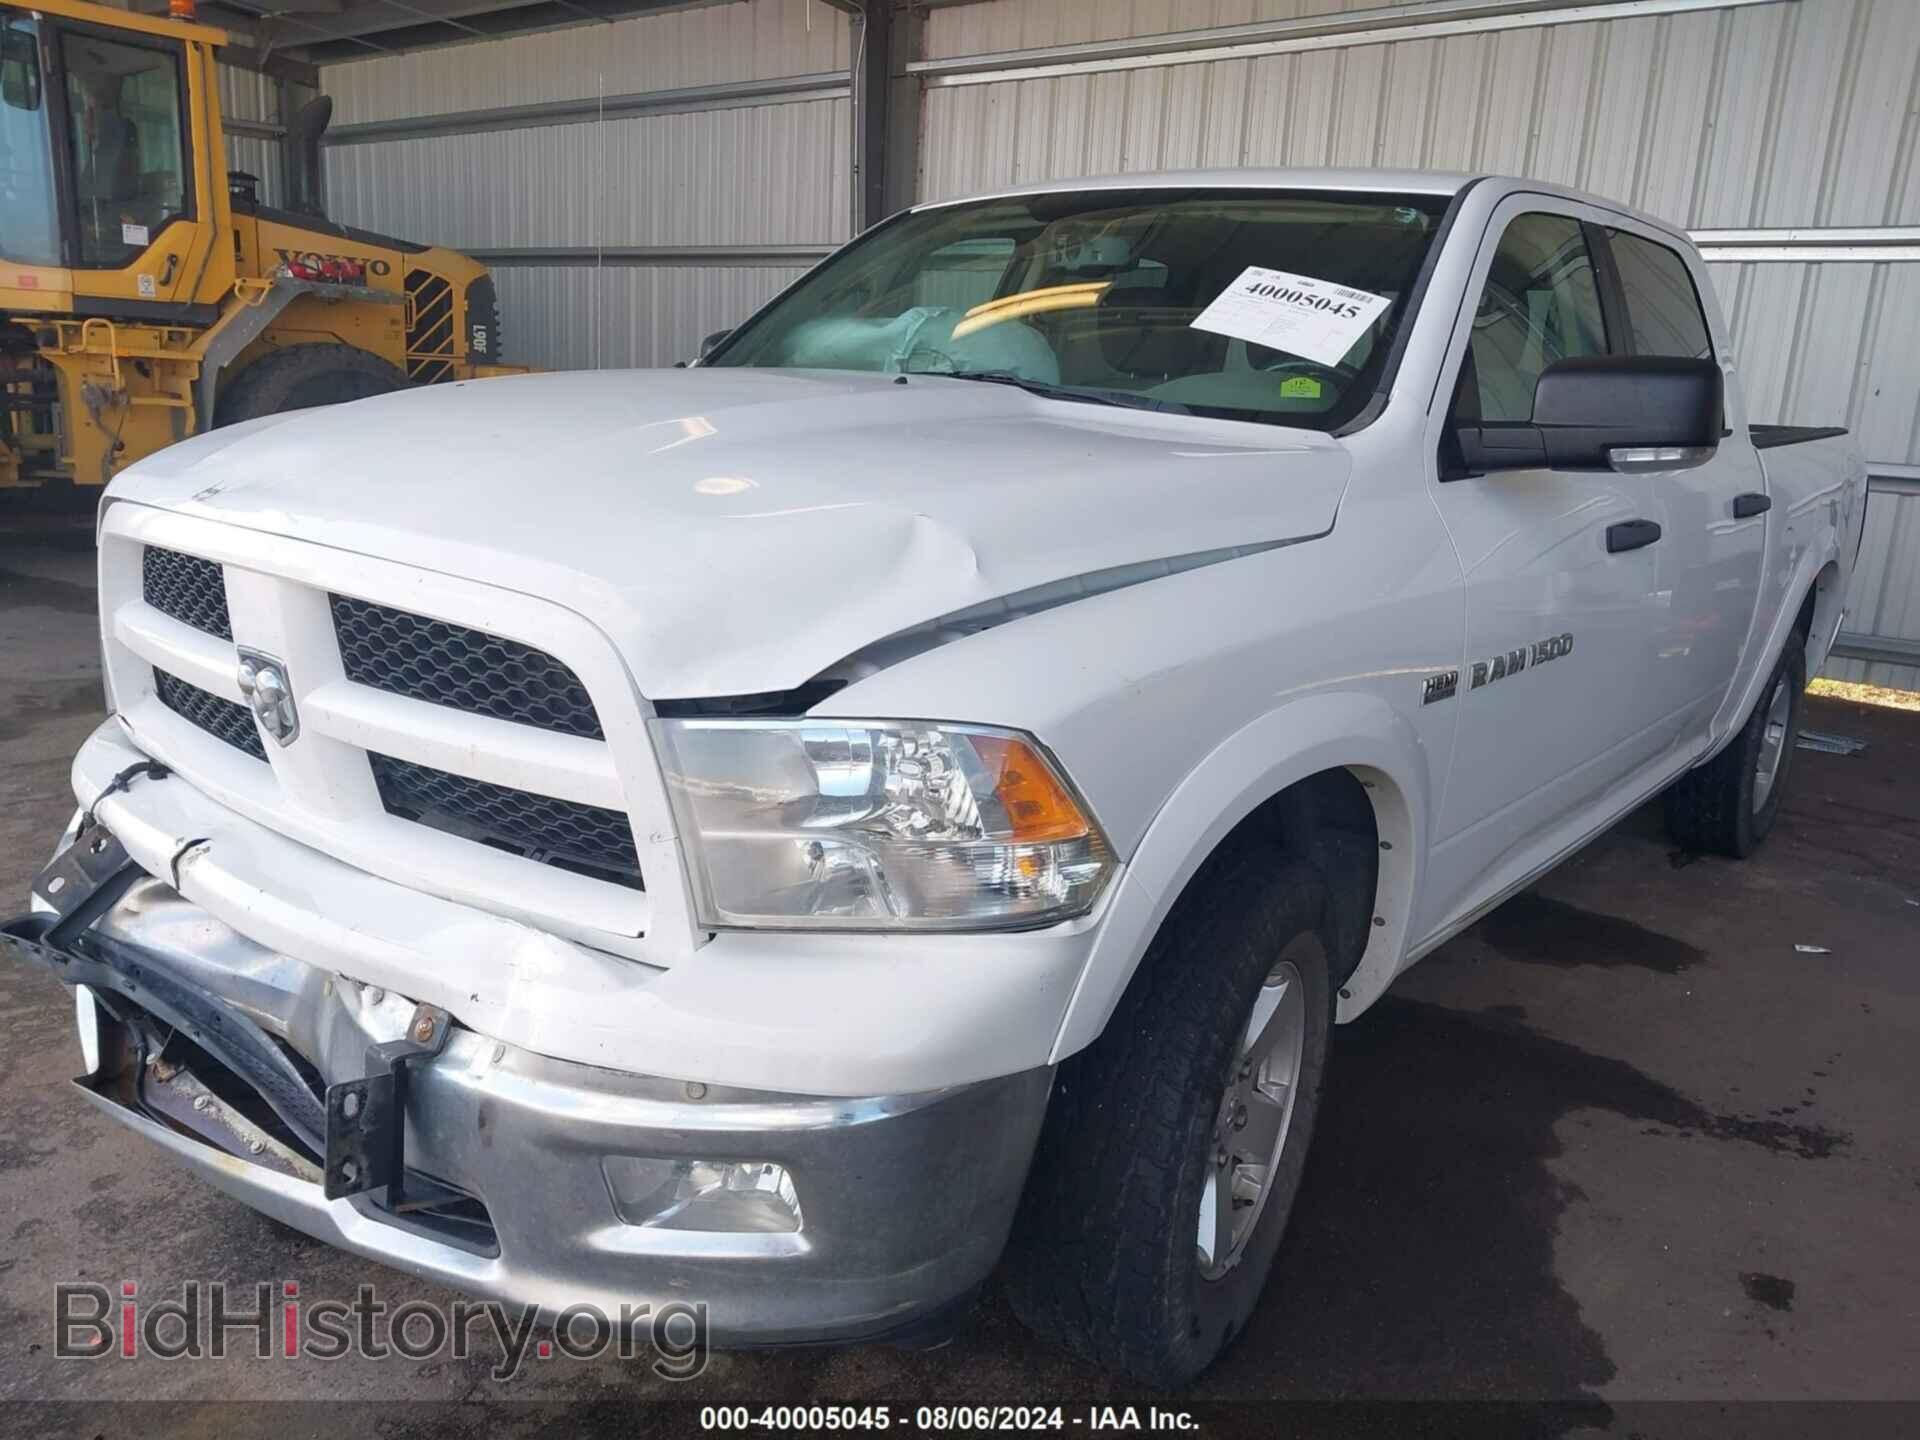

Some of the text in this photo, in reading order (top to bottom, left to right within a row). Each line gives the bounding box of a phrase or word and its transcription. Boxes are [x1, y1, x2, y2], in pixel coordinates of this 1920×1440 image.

[1245, 282, 1361, 319] 40005045
[472, 324, 487, 354] L90F
[1469, 632, 1574, 690] RAM 1500
[1423, 670, 1458, 695] HEMI
